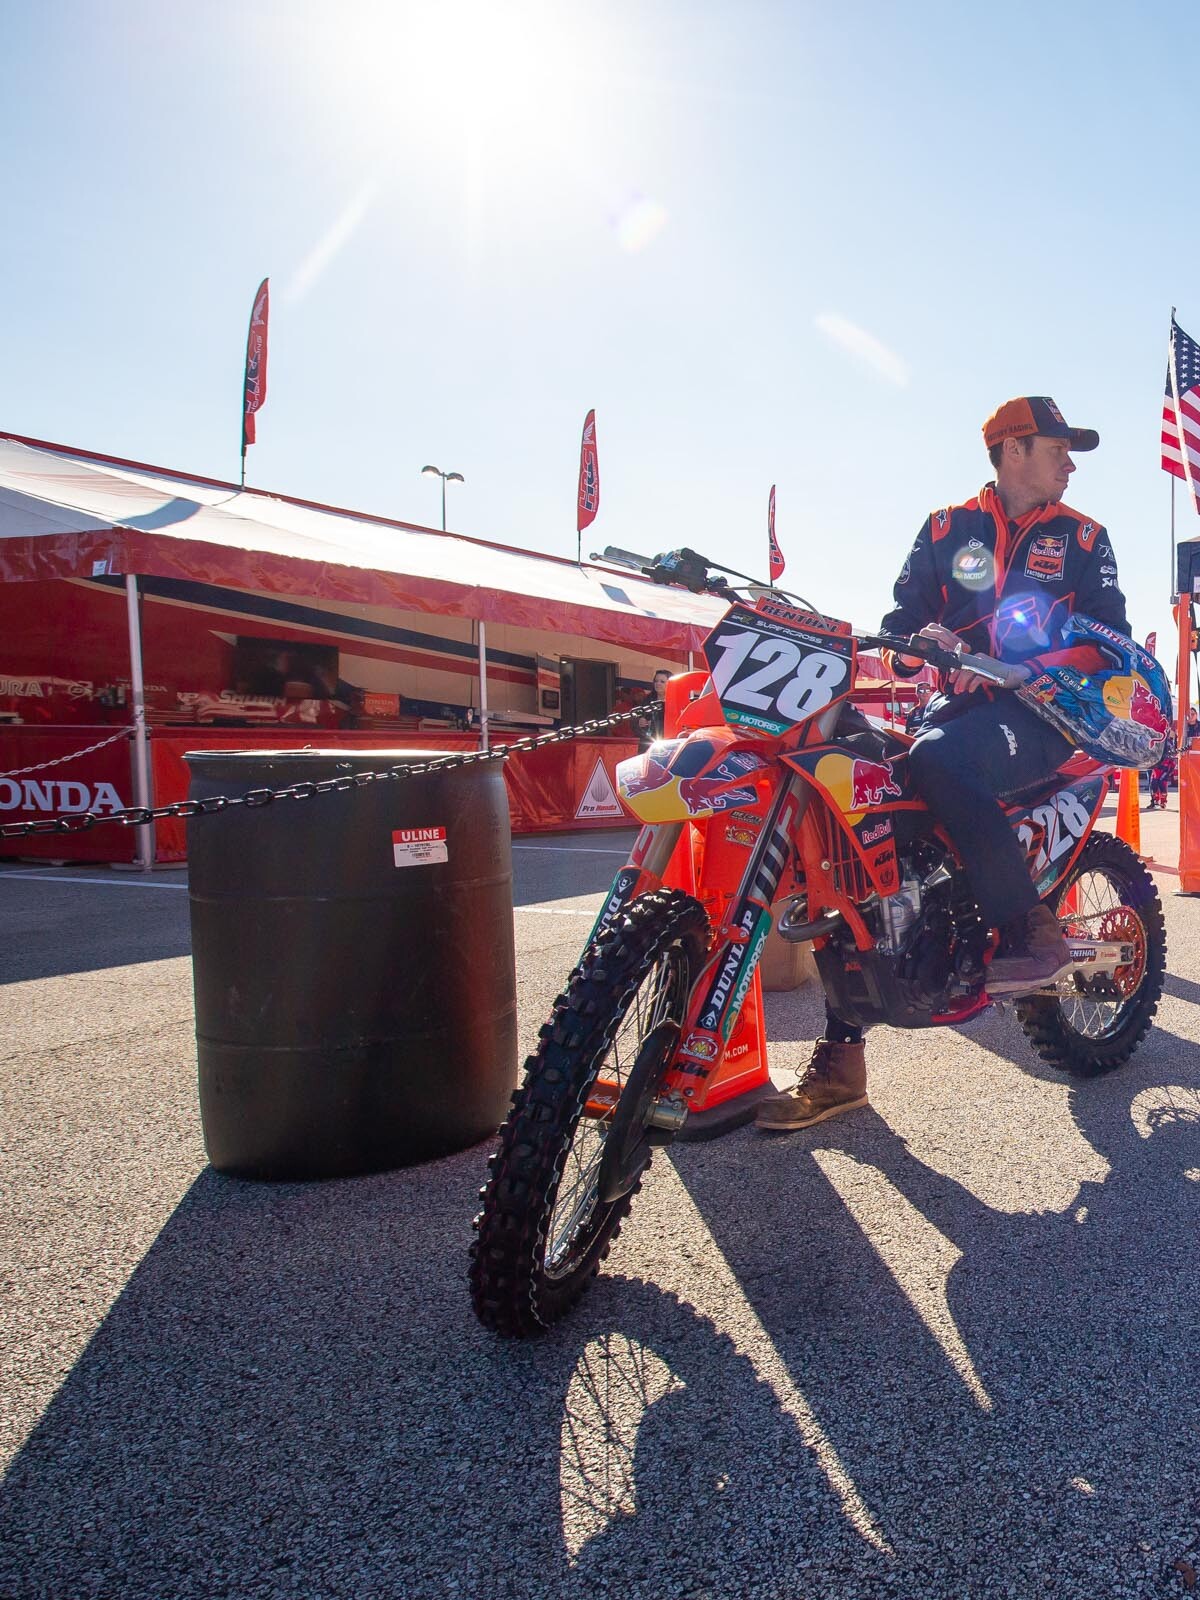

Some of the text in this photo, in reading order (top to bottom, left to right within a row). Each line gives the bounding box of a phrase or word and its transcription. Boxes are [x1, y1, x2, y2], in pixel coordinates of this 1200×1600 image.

[755, 620, 824, 645] SUPERCROSS
[711, 631, 847, 722] 128
[739, 714, 782, 733] MOTOREX
[0, 778, 126, 815] ONDA
[581, 804, 595, 812] Pro
[401, 828, 440, 842] ULINE
[1070, 949, 1096, 958] ENTHAL
[732, 928, 768, 1012] MOTOREX
[724, 1044, 748, 1060] M.COM
